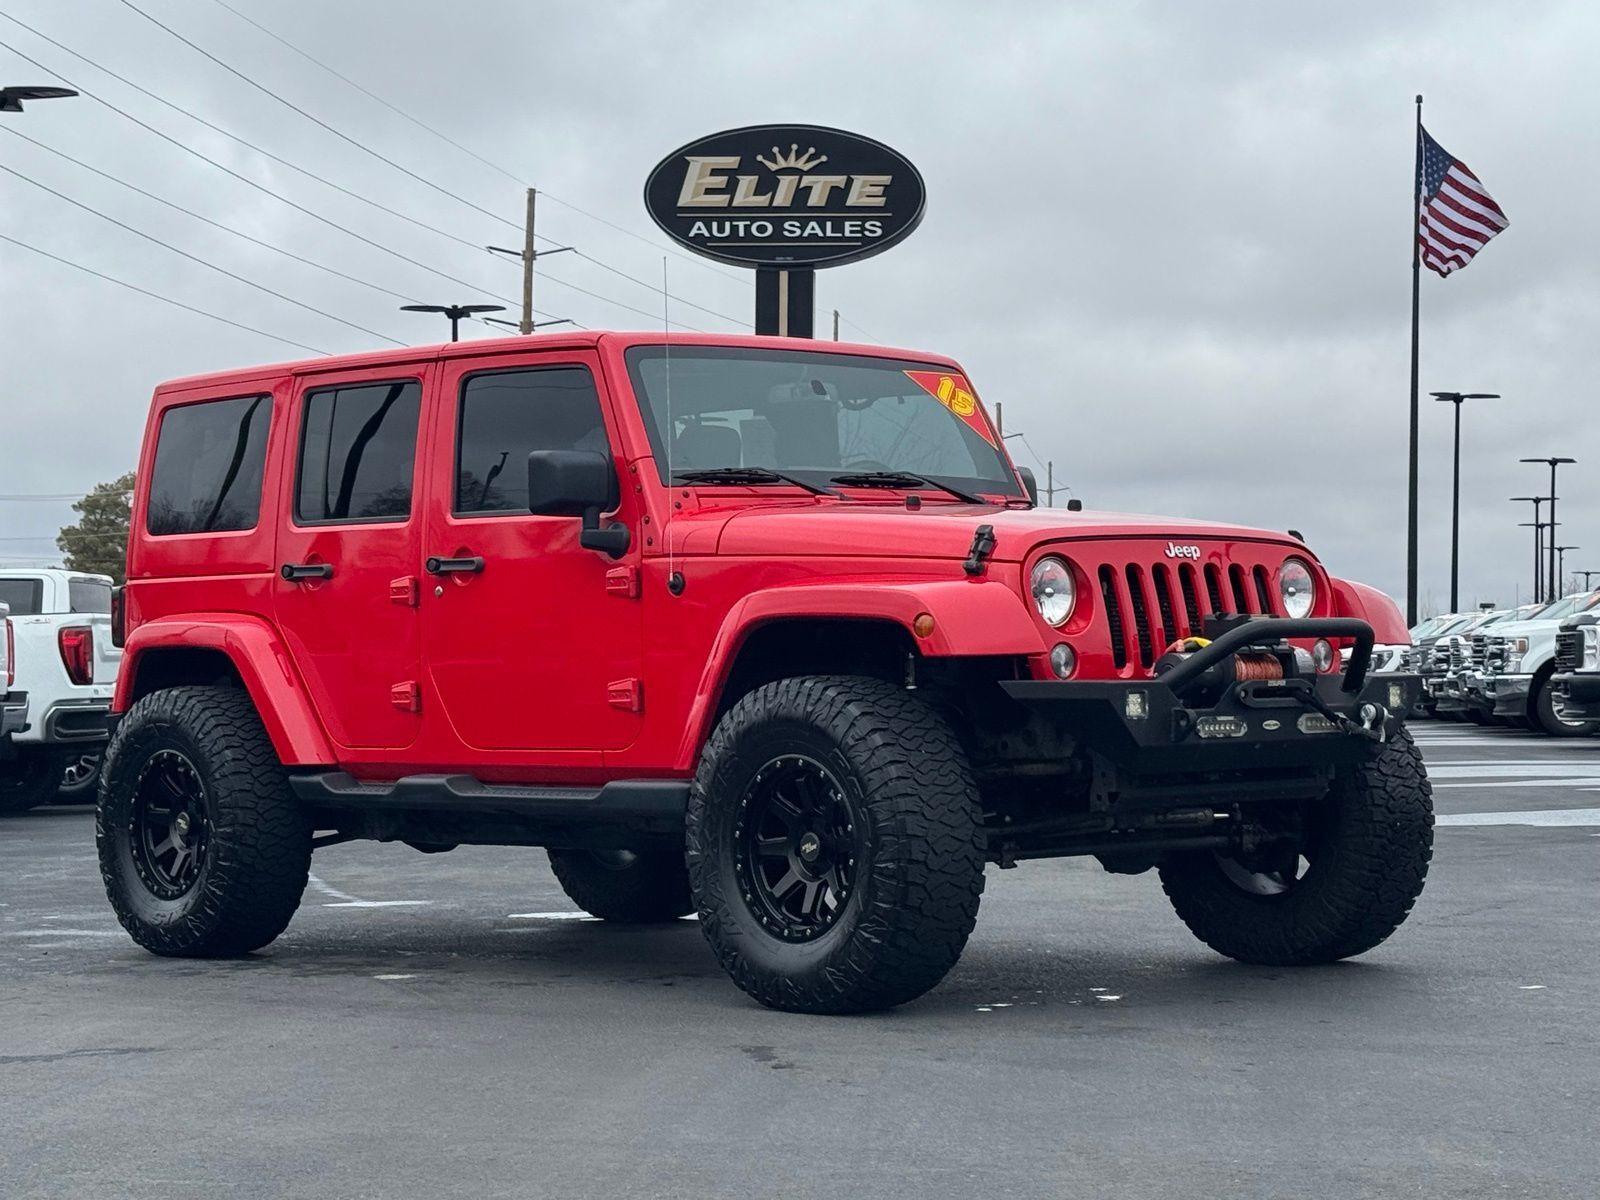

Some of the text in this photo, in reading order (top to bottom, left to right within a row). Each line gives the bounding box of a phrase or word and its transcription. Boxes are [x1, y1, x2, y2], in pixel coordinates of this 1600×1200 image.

[676, 156, 893, 208] ELITE
[688, 220, 883, 238] AUTO SALES
[937, 376, 975, 417] 15
[1164, 541, 1201, 561] Jeep
